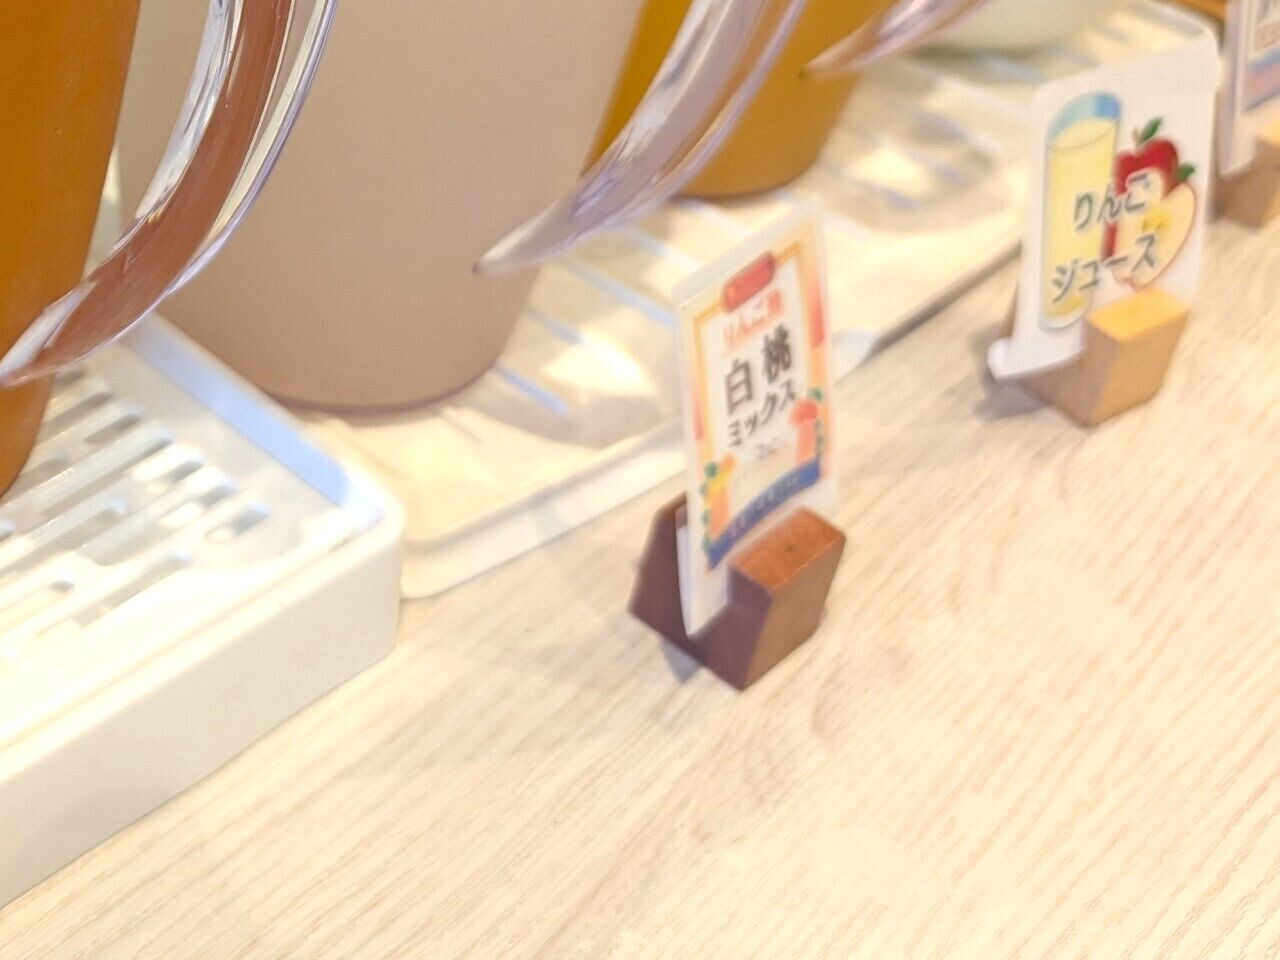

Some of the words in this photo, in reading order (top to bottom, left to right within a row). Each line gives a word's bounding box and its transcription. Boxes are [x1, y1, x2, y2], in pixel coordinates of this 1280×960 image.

[1073, 173, 1152, 231] りんご
[1051, 234, 1156, 304] ジュース
[725, 324, 793, 416] 白桃
[728, 379, 797, 447] ミックス
